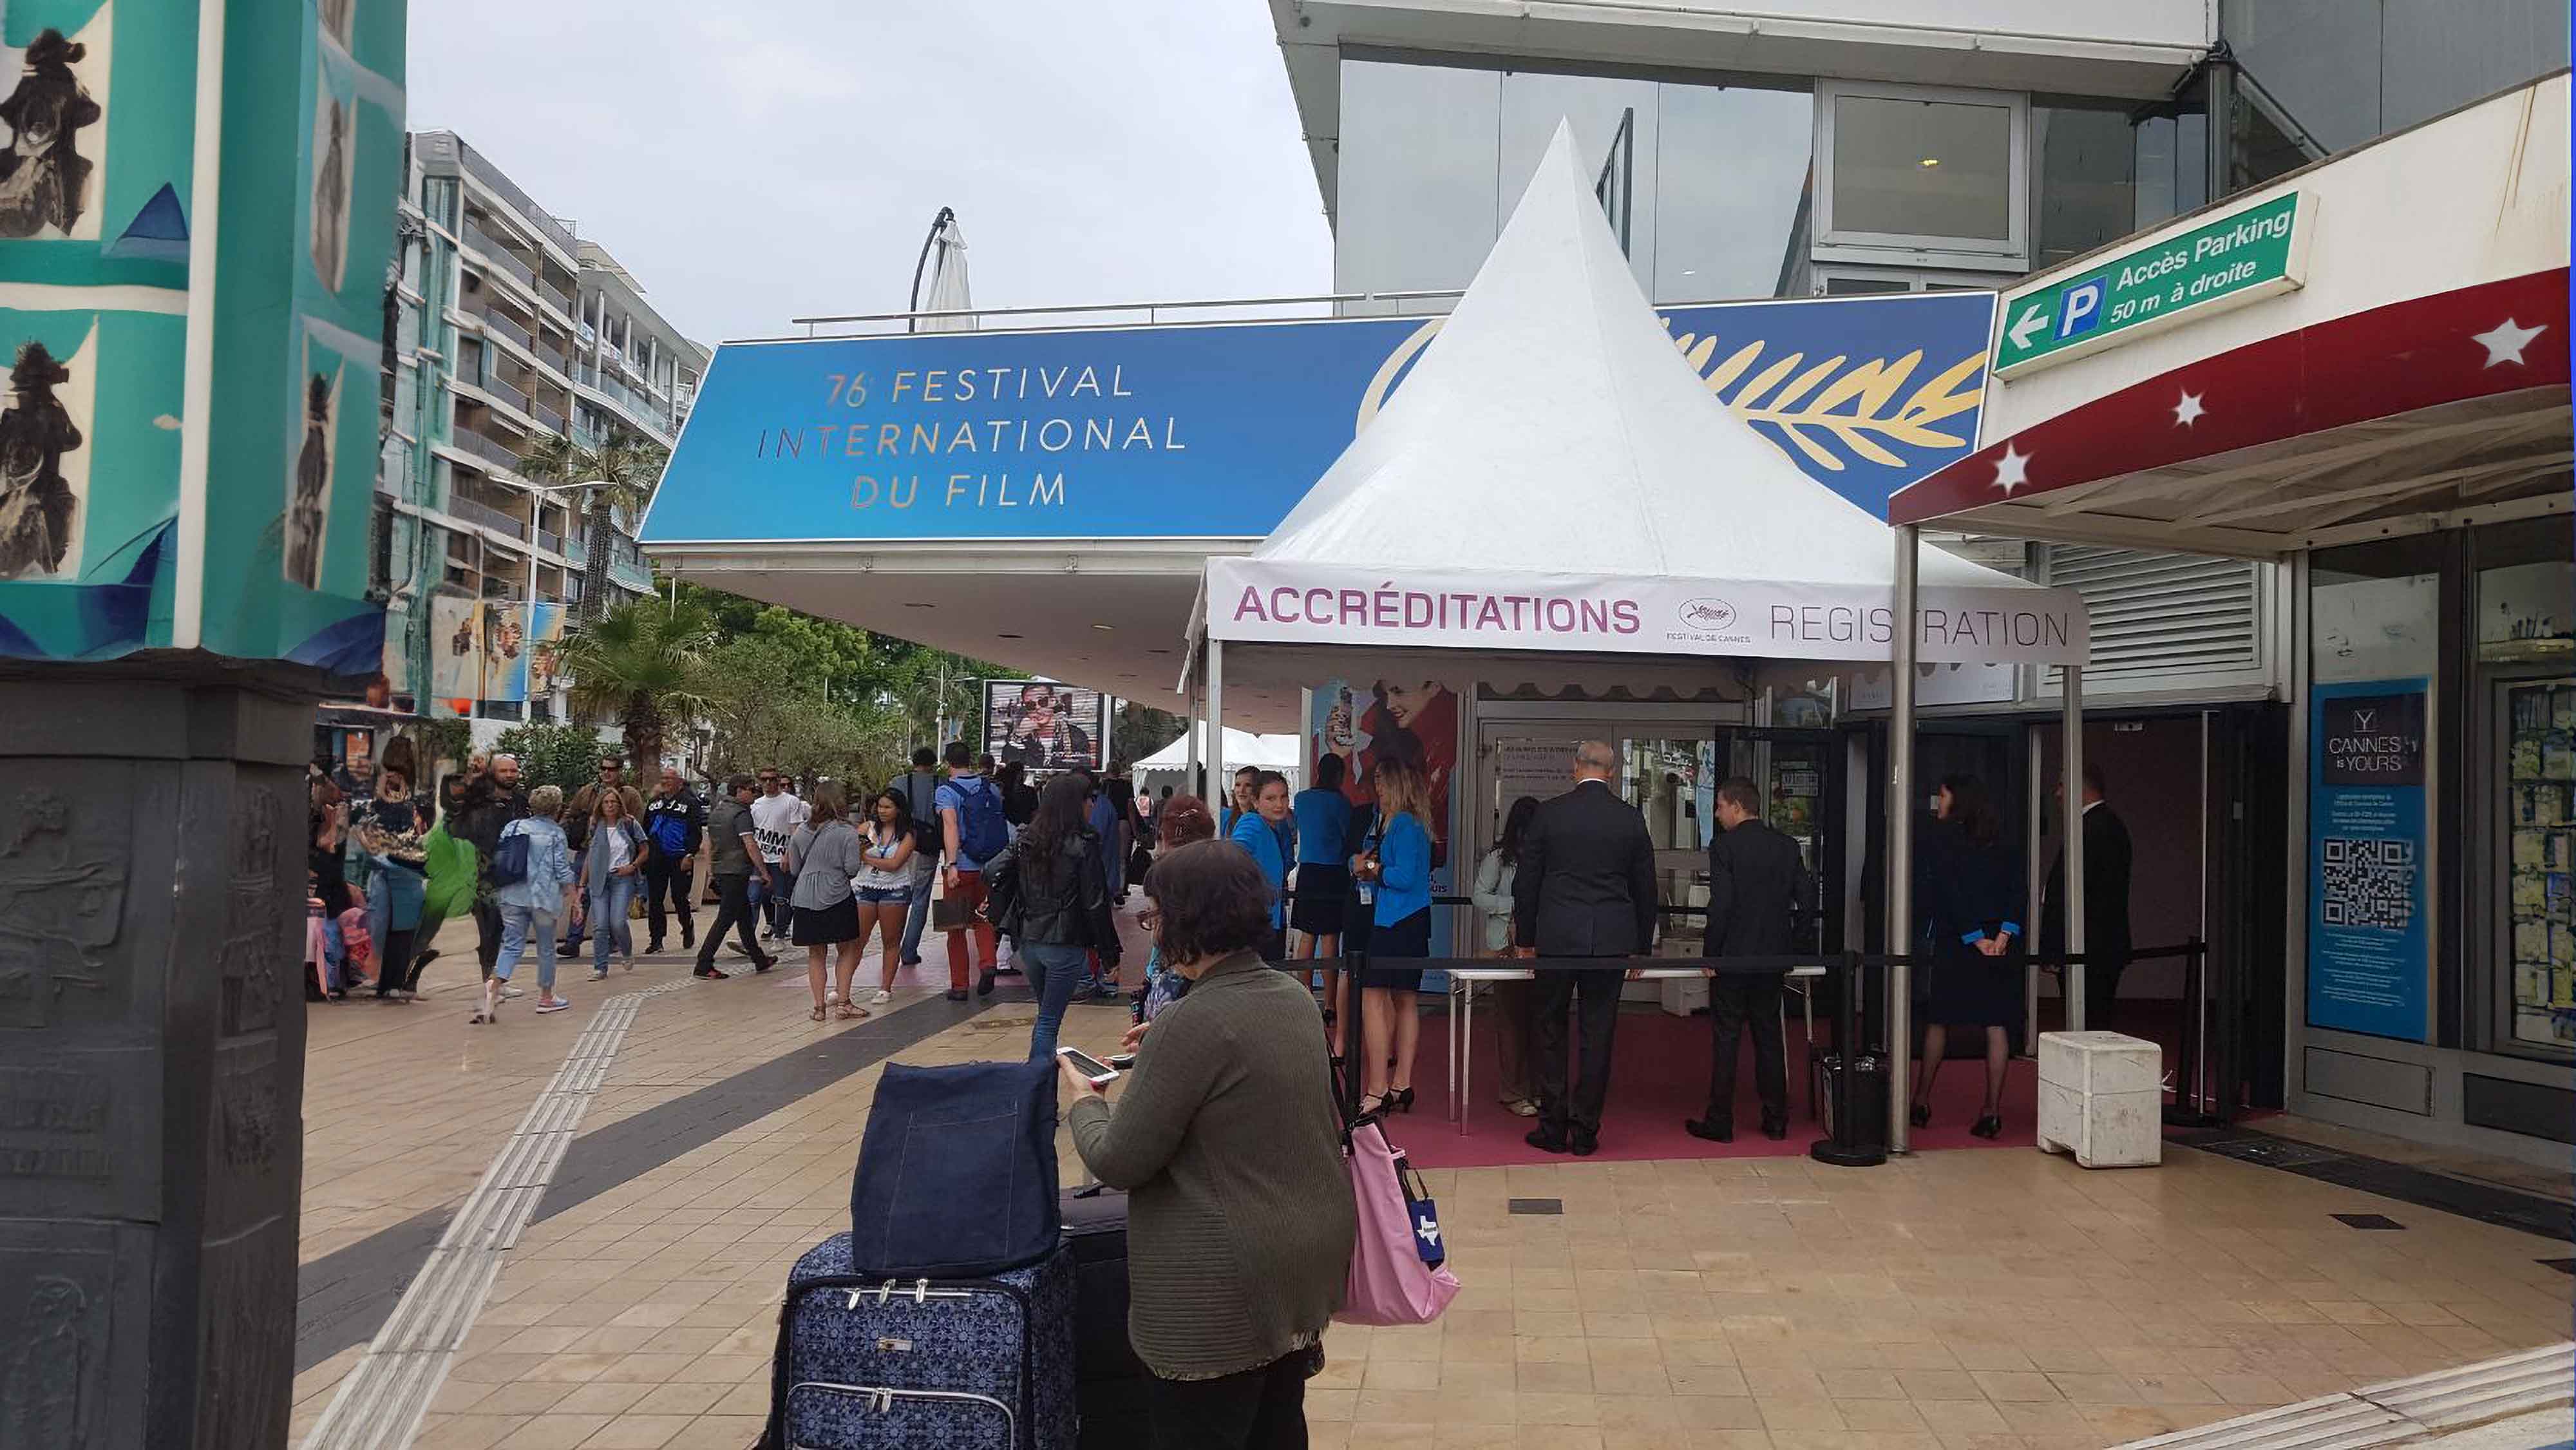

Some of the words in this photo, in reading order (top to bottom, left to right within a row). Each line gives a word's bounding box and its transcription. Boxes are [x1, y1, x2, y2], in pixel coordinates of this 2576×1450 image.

[2116, 250, 2188, 291] Accès
[2193, 211, 2291, 263] Parking
[2110, 299, 2136, 323] 50
[2139, 294, 2161, 314] m
[2170, 281, 2184, 303] à
[2190, 260, 2257, 296] droite
[892, 364, 1132, 403] FESTIVAL
[757, 417, 1186, 459] INTERNATIONAL
[851, 475, 919, 509] DU
[945, 472, 1065, 508] FILM
[1233, 580, 1641, 634] ACCRÉDITATIONS
[1771, 604, 2068, 647] REGISRATION
[2329, 736, 2402, 754] CANNES
[2345, 755, 2402, 772] YOURS
